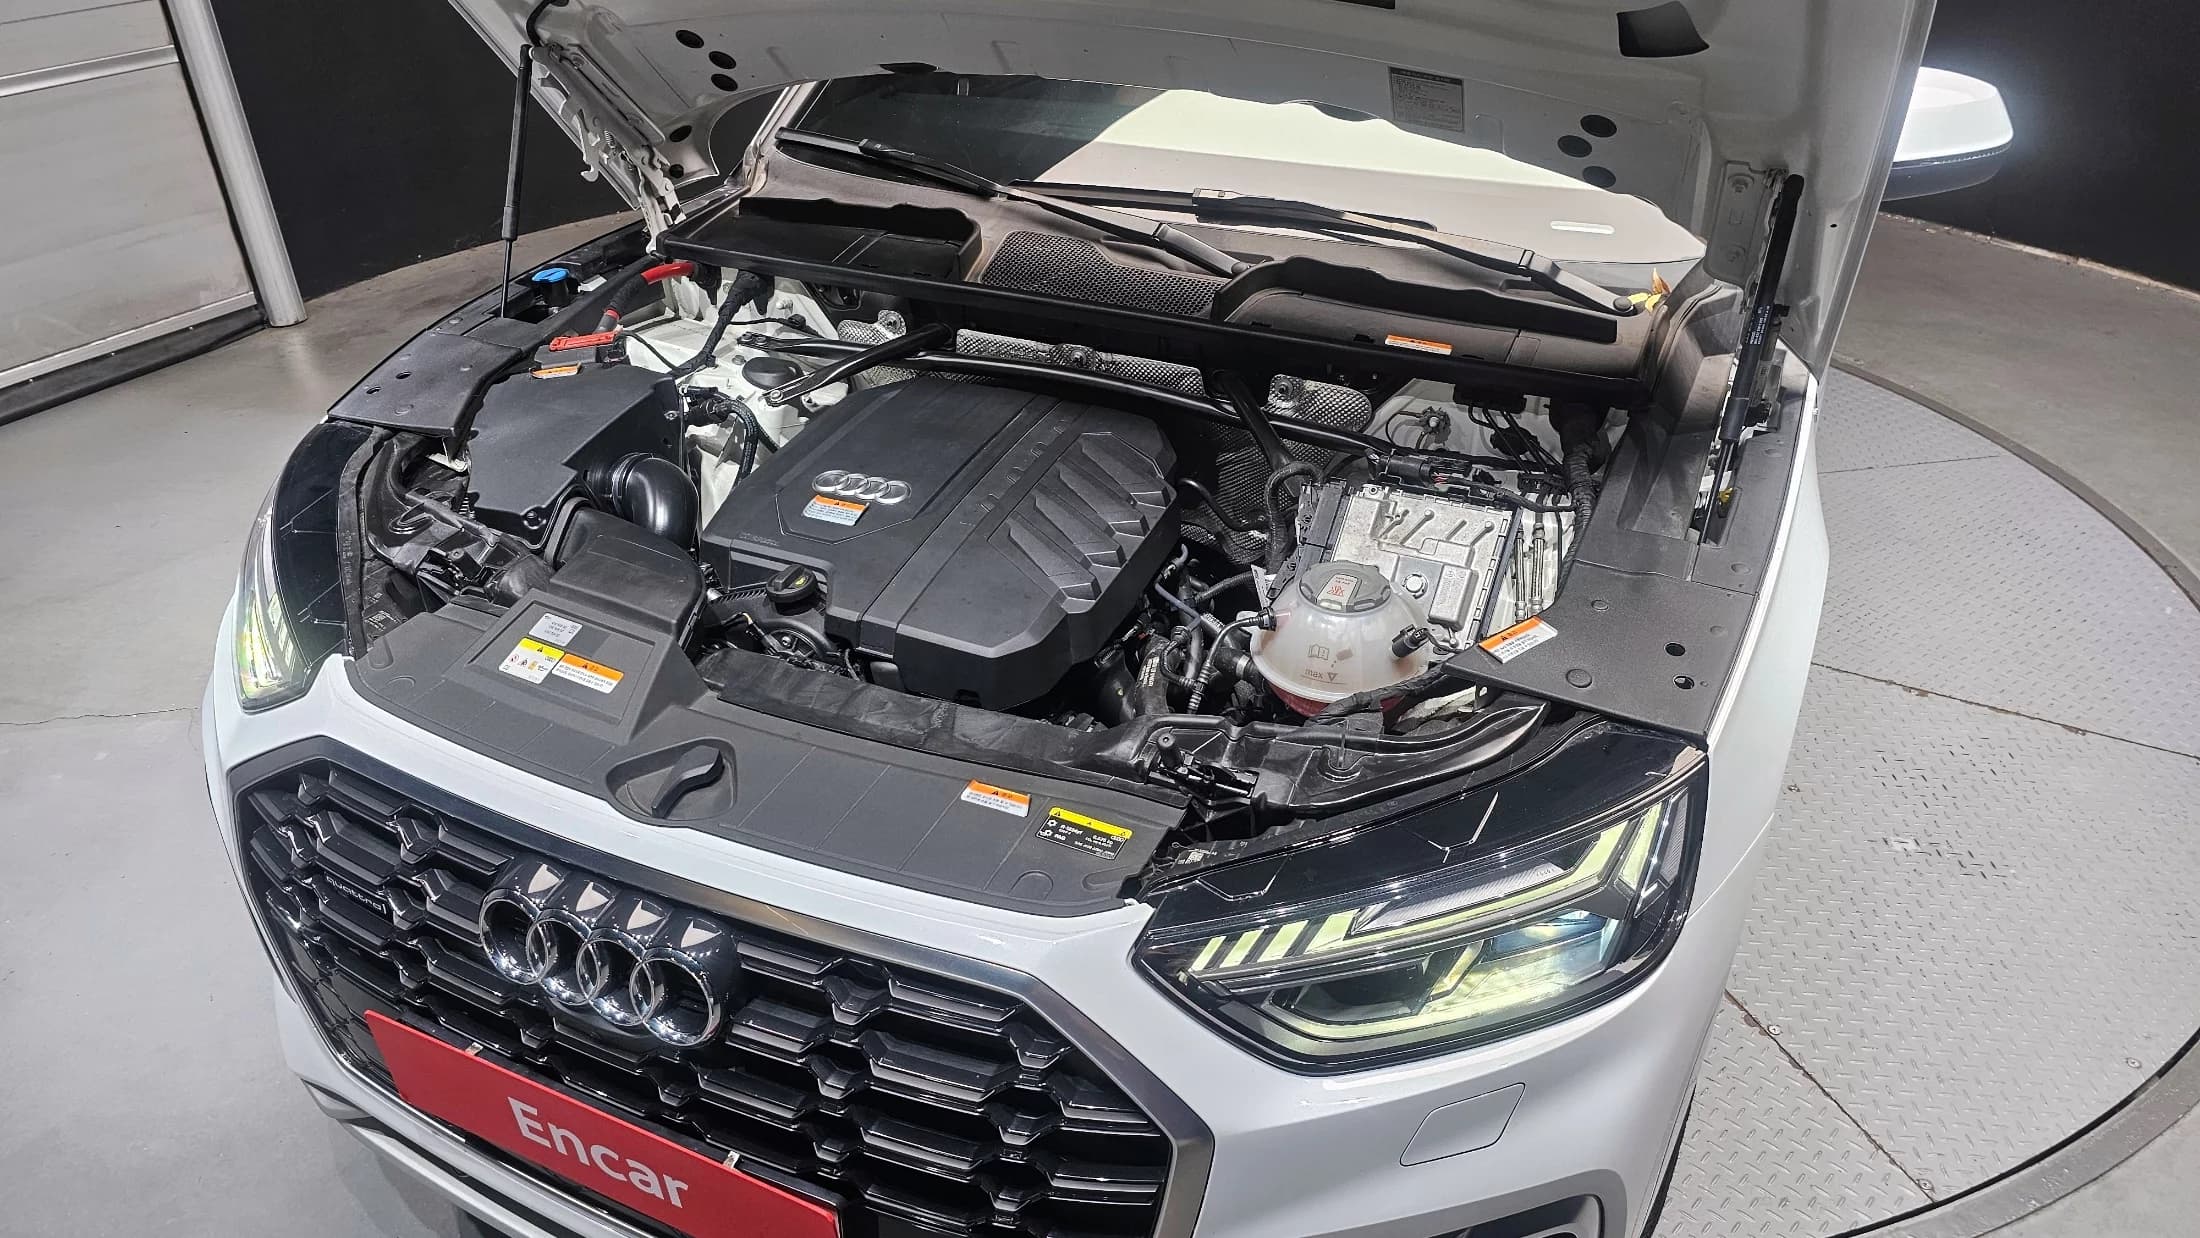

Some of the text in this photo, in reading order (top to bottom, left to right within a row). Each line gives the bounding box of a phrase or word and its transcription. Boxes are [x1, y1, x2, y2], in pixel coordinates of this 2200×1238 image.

[1305, 669, 1323, 679] max
[326, 876, 382, 911] quattro
[507, 1096, 689, 1209] Encar
